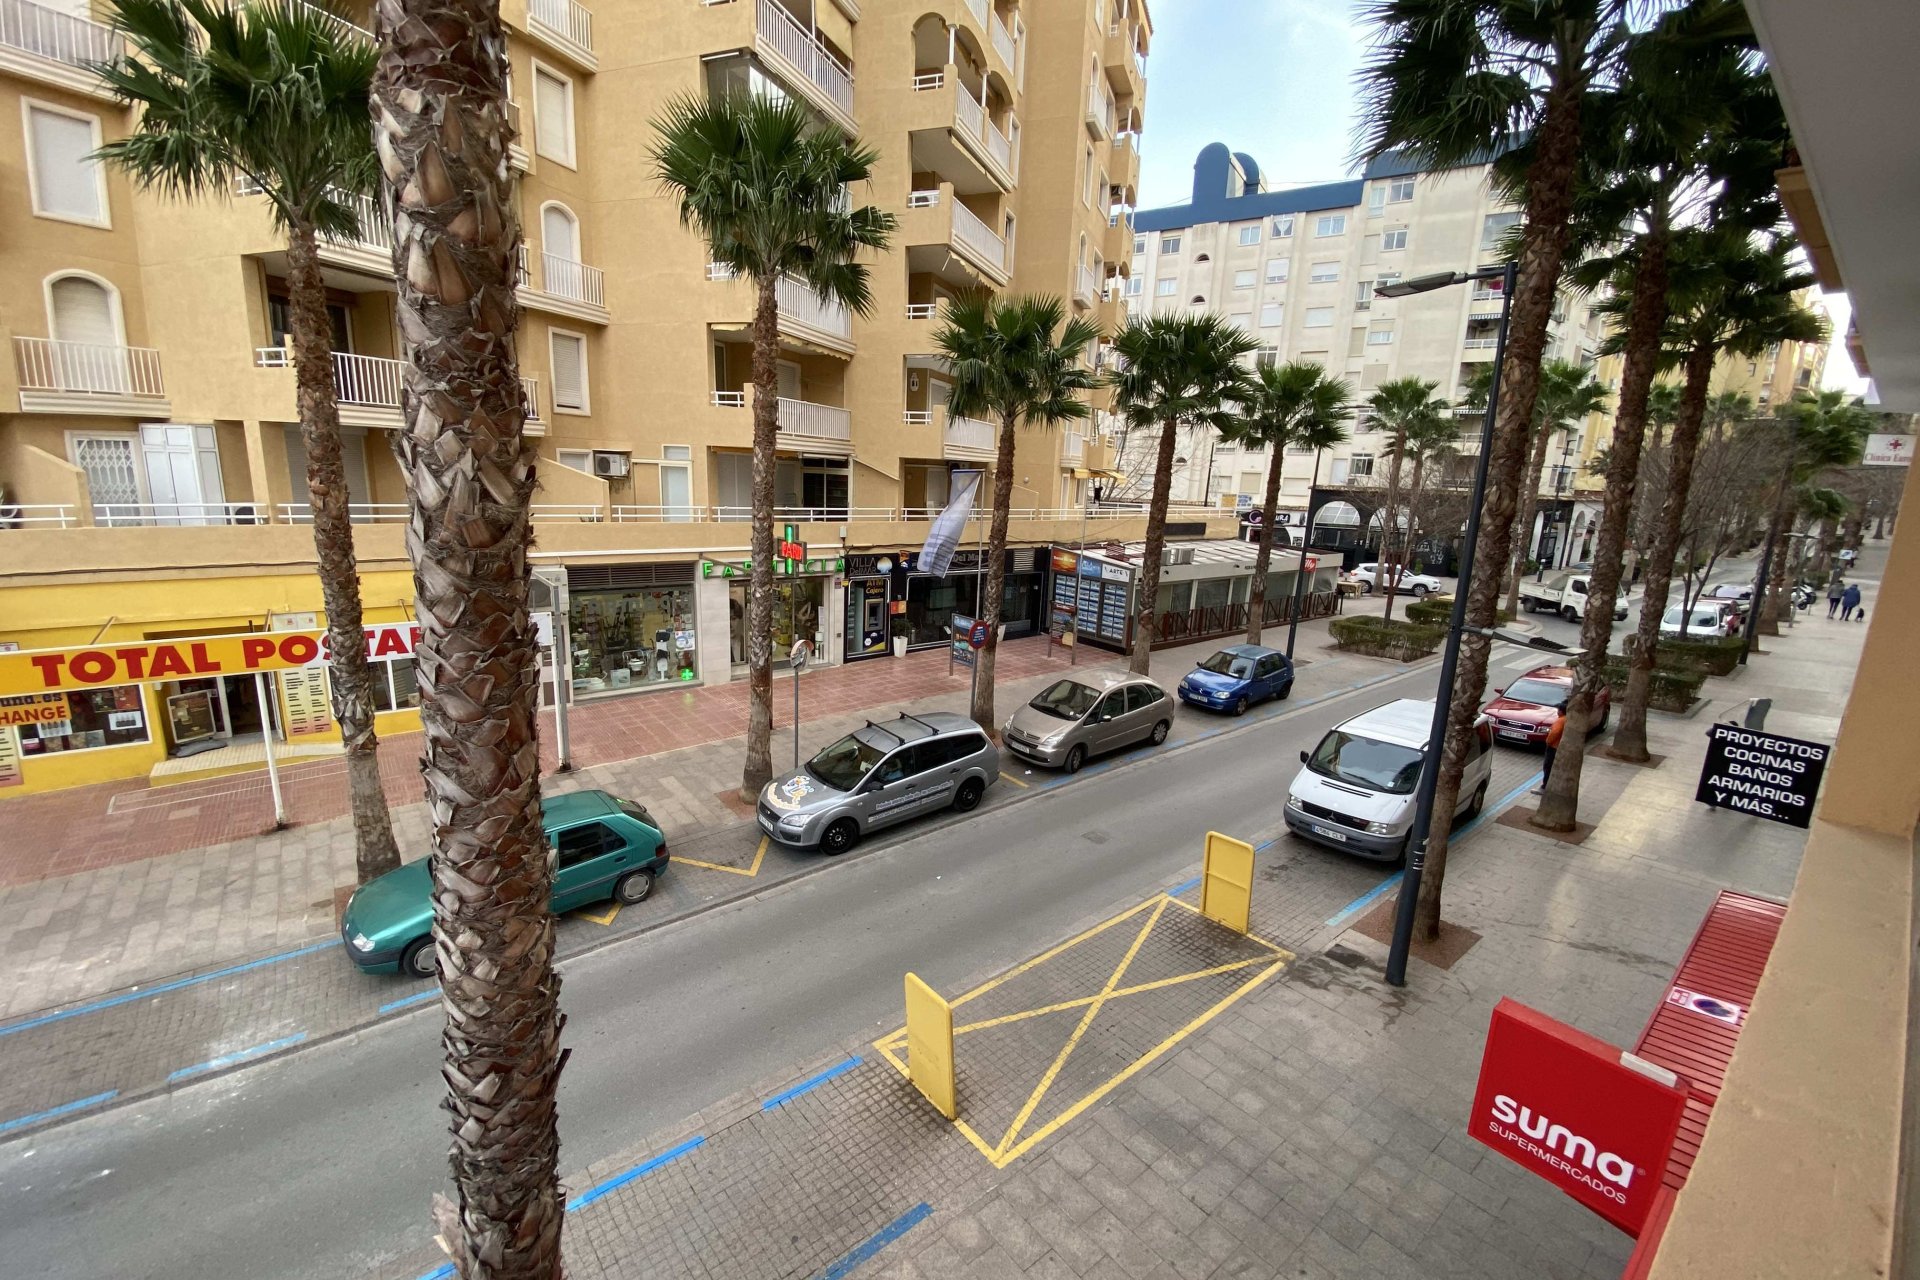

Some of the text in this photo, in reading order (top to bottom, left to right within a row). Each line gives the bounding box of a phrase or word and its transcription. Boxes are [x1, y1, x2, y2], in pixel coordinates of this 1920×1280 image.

[703, 558, 845, 580] FARCIA
[849, 557, 876, 568] VILLA
[865, 587, 884, 595] Cajero
[866, 578, 884, 587] ATM
[31, 642, 221, 687] TOTAL
[1715, 728, 1824, 760] PROYECTOS
[1724, 746, 1806, 773] COCINAS
[1728, 763, 1793, 787] BAÑOS
[1707, 774, 1806, 807] ARMARIOS
[1714, 790, 1728, 803] Y
[1491, 1094, 1634, 1188] suma
[1489, 1121, 1627, 1204] SUPERMERCADOS
